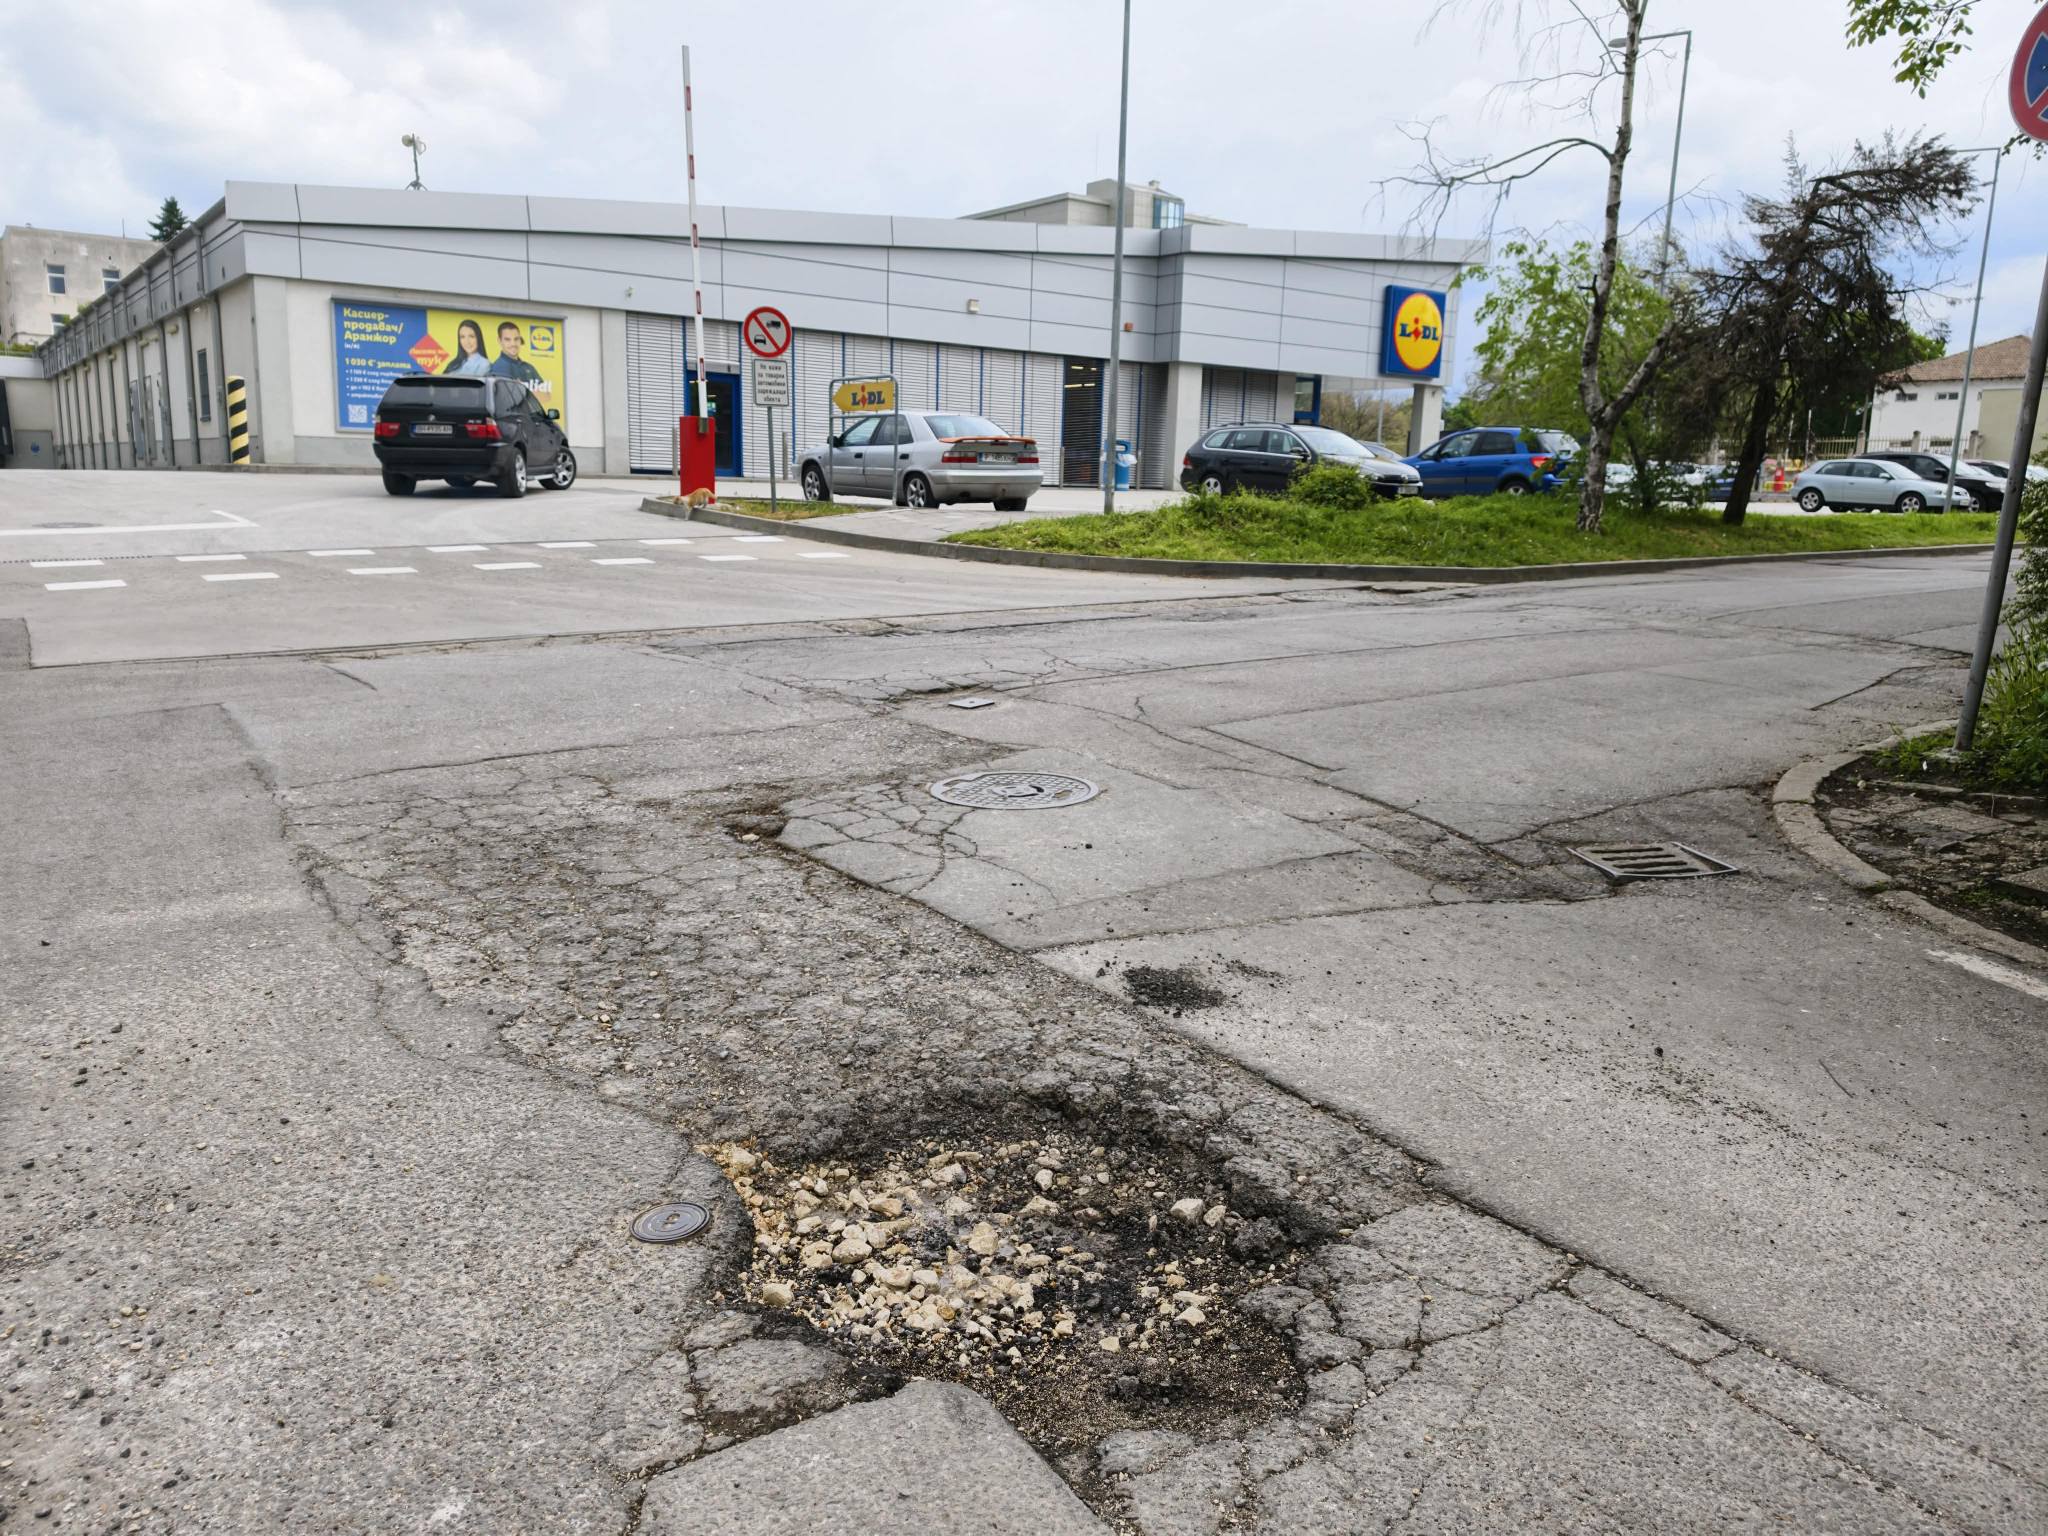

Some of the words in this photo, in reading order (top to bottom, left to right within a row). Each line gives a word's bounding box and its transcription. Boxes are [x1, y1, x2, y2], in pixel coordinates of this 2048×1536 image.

[343, 307, 390, 321] Касиер-
[343, 320, 404, 334] продавач/
[344, 330, 397, 346] Аранжор
